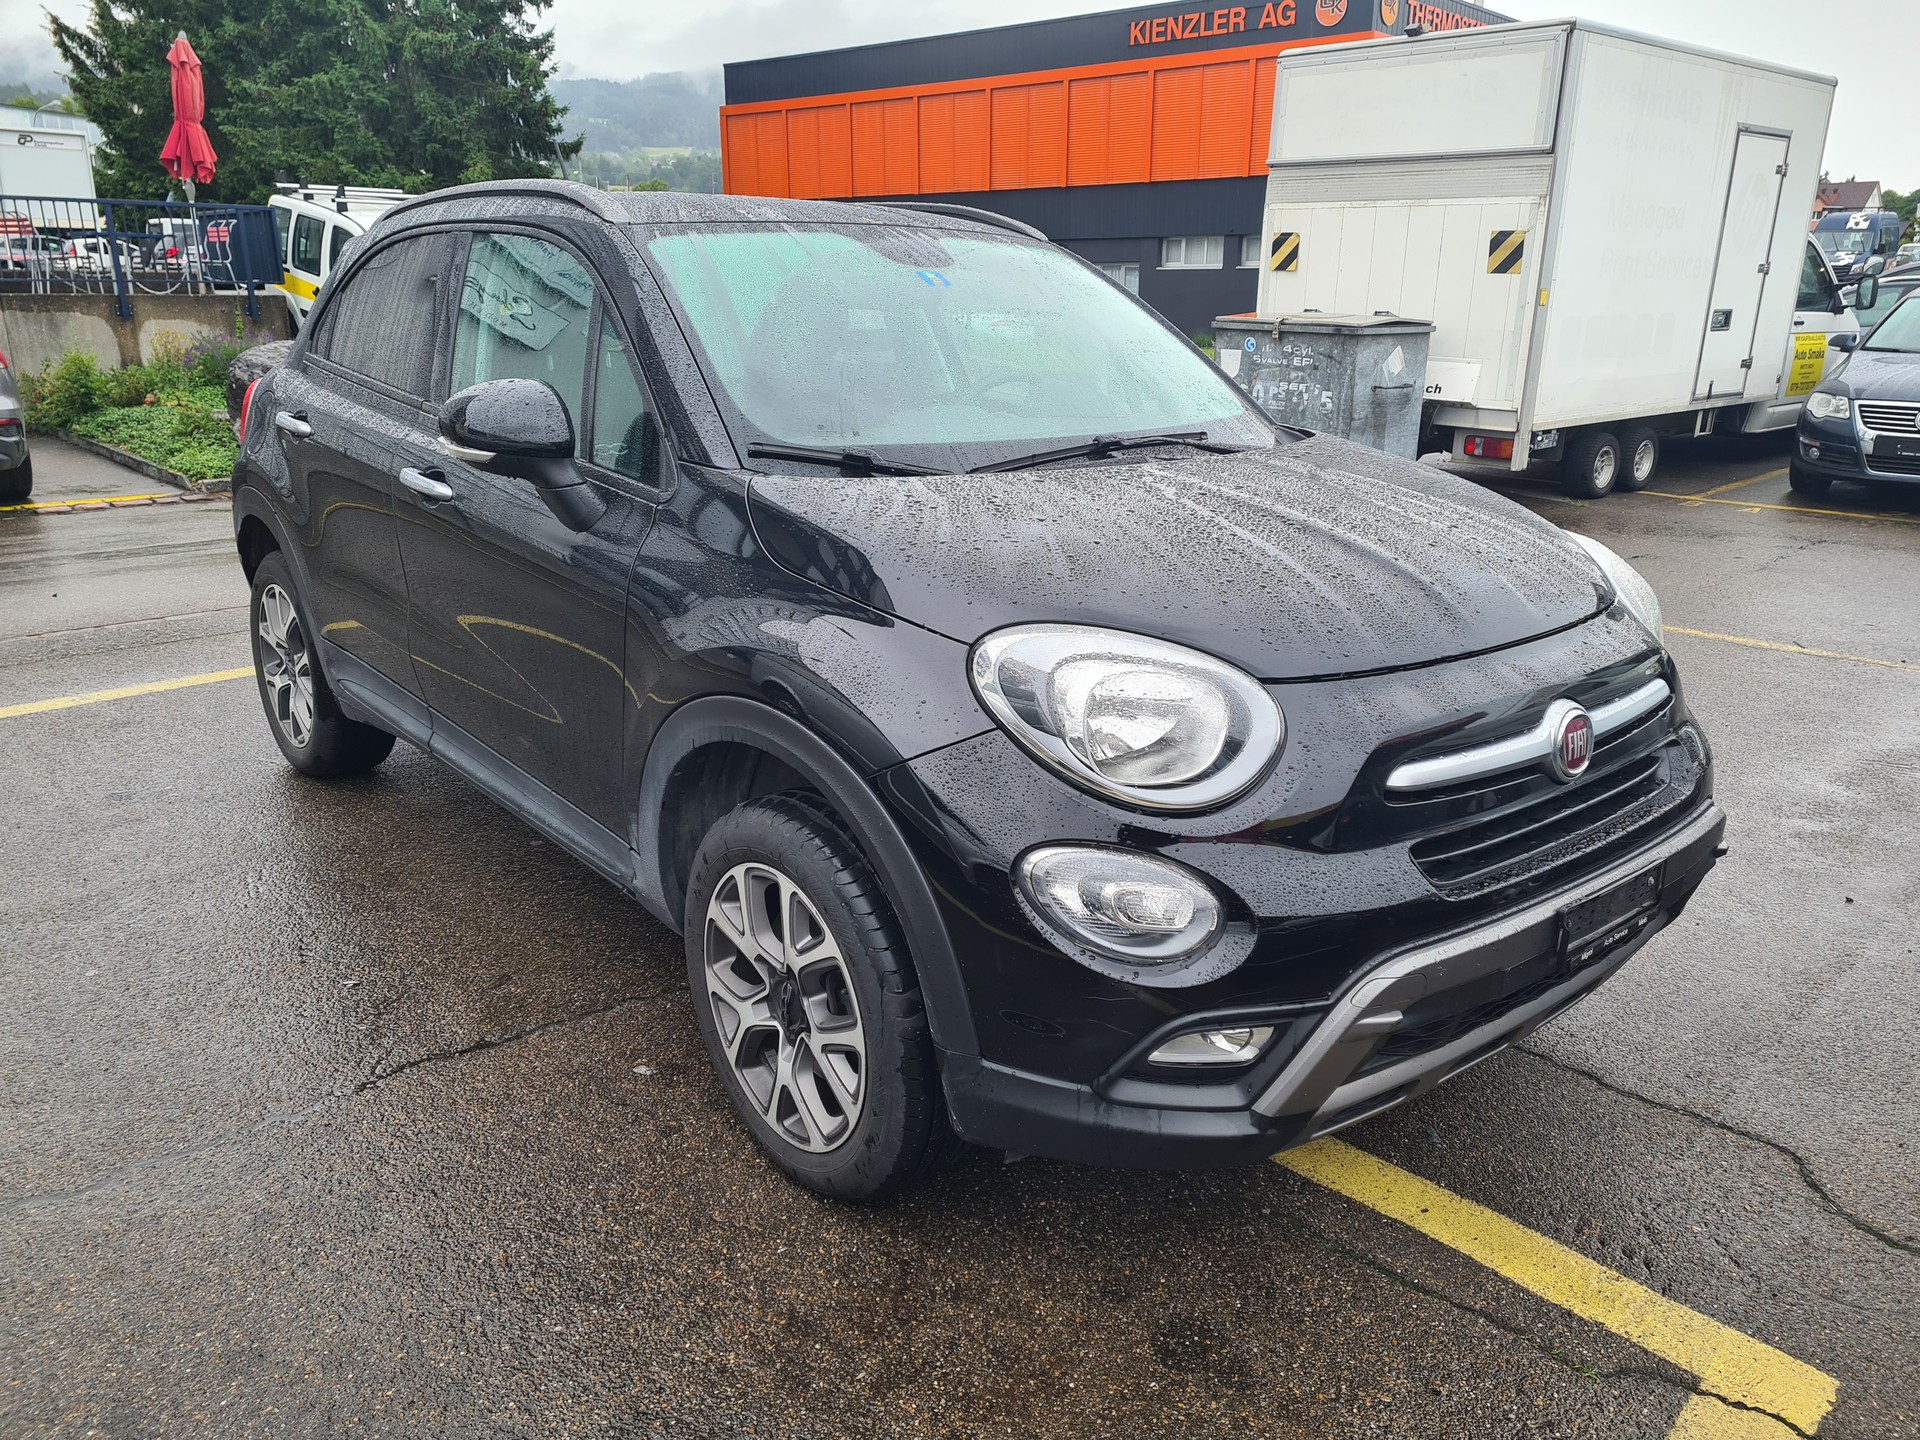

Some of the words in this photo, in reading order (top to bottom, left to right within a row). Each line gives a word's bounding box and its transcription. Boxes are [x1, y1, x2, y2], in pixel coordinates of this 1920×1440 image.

[1129, 6, 1247, 46] KIENZLER
[1258, 0, 1296, 29] AG
[1567, 727, 1588, 762] FIAT
